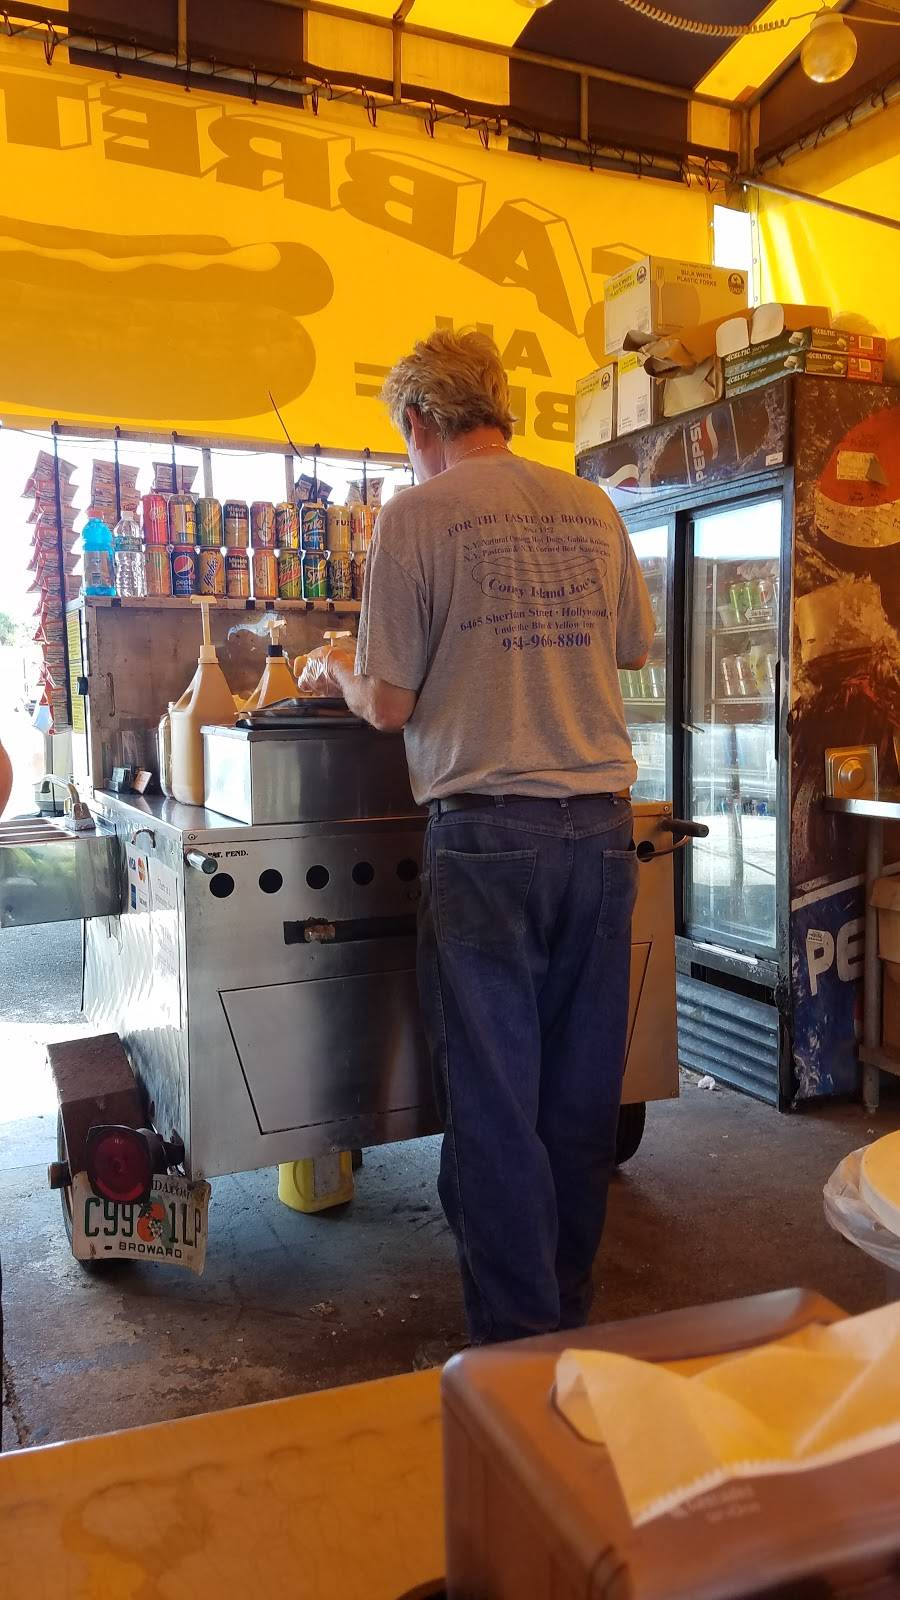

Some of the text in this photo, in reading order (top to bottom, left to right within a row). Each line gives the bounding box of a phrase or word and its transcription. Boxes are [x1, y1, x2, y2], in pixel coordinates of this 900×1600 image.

[690, 422, 706, 482] PEPSI
[447, 520, 473, 537] FOR
[504, 513, 537, 524] TASTE
[488, 578, 597, 599] Coney Island Joe's
[460, 616, 483, 632] 6465
[555, 621, 579, 630] Yellow
[502, 632, 592, 653] 954-966-8800
[225, 850, 249, 858] PEND.
[119, 1241, 183, 1259] BROWARD
